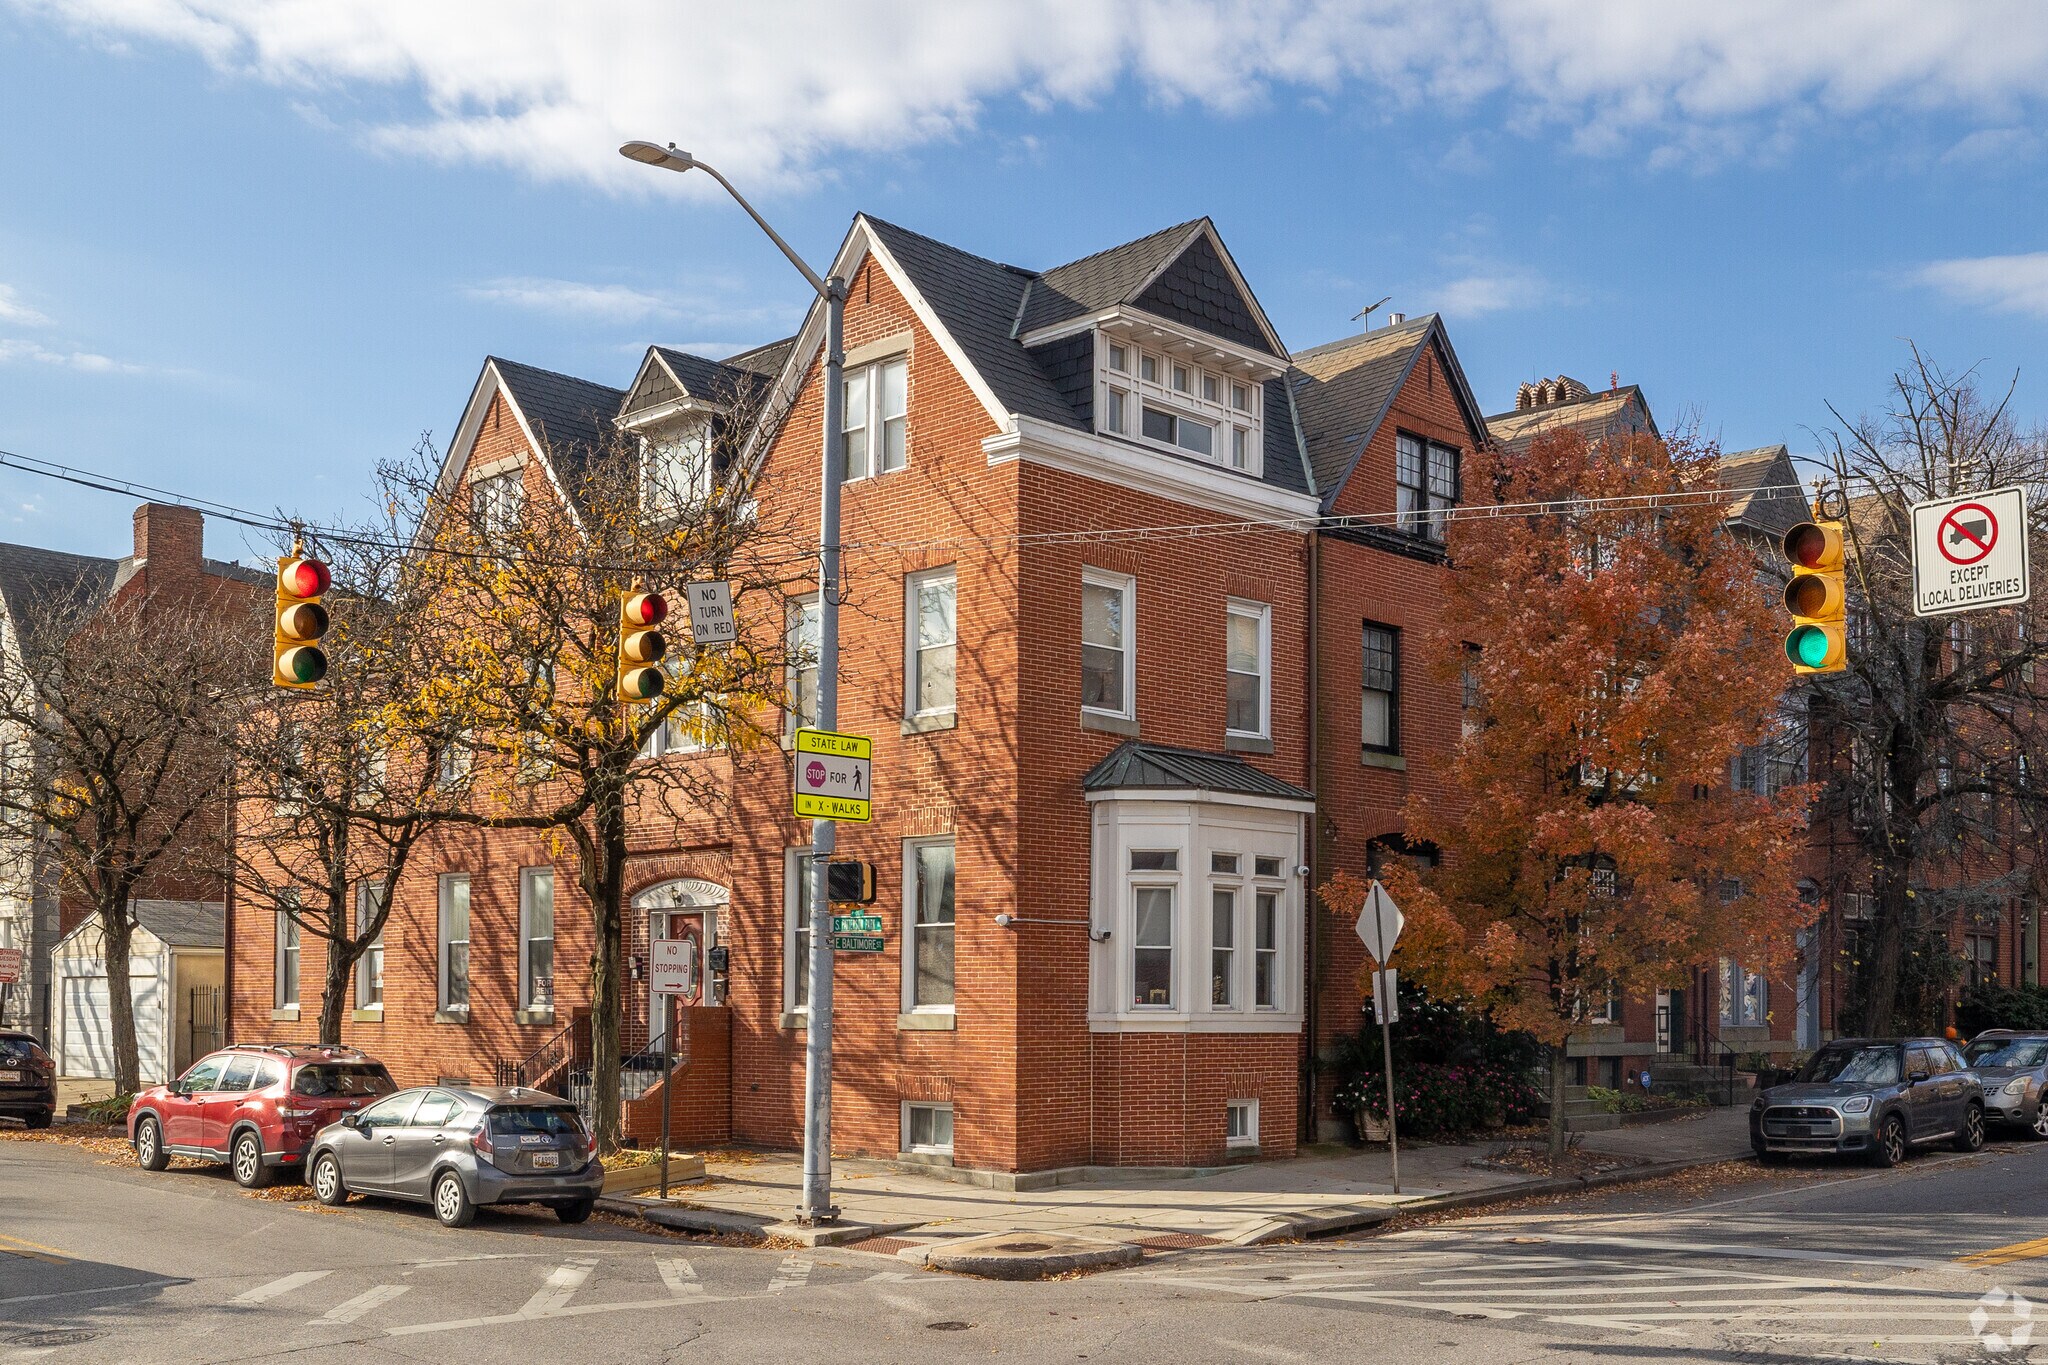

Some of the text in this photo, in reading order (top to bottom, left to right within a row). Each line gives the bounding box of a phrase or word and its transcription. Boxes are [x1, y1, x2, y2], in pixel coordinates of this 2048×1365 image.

[1950, 565, 1989, 584] EXCEPT
[701, 589, 717, 601] NO
[1923, 578, 2020, 606] LOCAL DELIVERIES
[699, 605, 724, 618] TURN
[696, 622, 732, 636] ON RED
[811, 737, 858, 752] STATE LAW
[807, 768, 847, 784] STOP FOR
[805, 800, 811, 809] IN
[666, 945, 678, 956] NO
[841, 938, 877, 950] BALTIMORE
[655, 963, 688, 974] STOPPING
